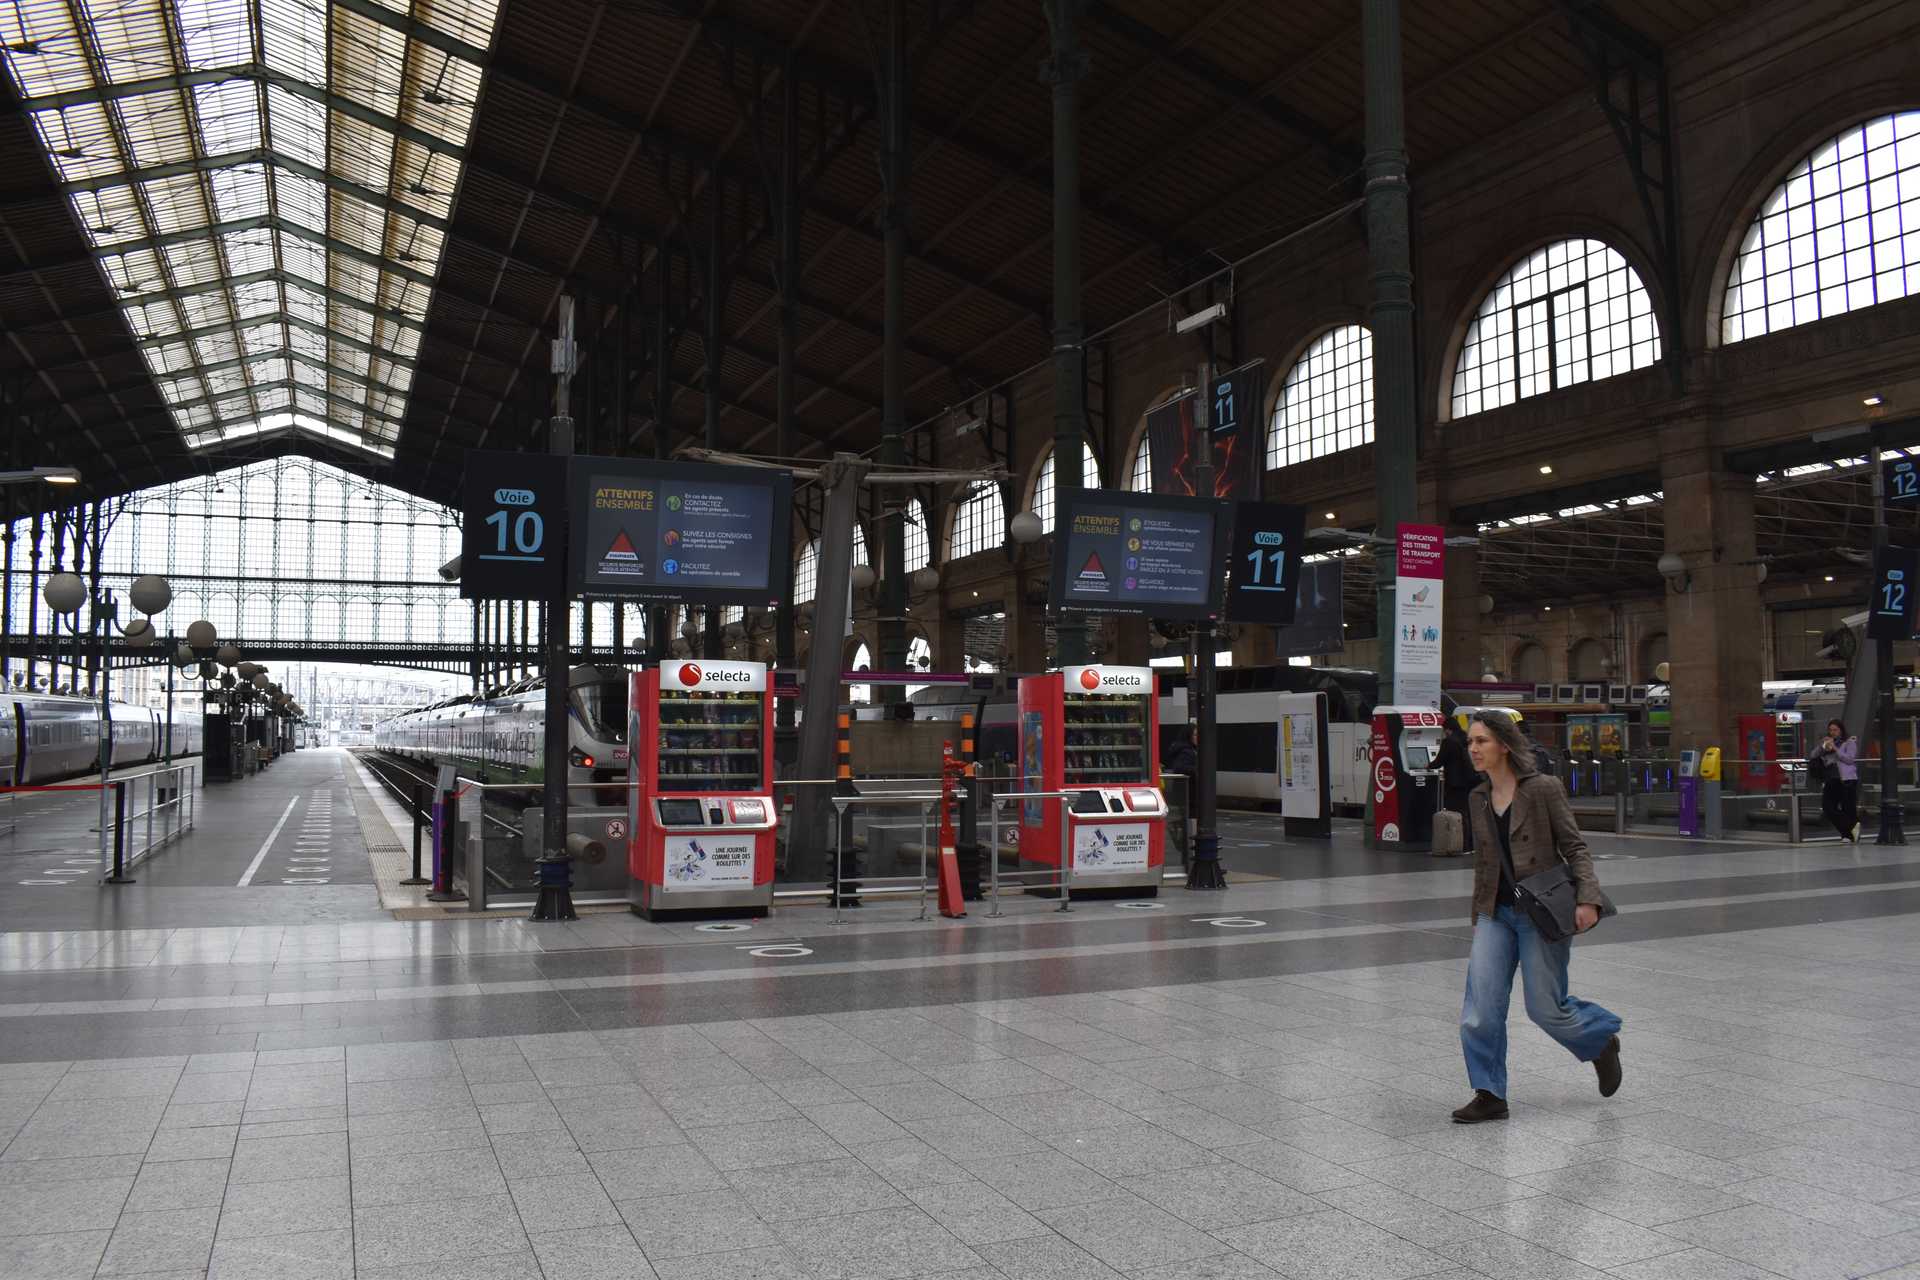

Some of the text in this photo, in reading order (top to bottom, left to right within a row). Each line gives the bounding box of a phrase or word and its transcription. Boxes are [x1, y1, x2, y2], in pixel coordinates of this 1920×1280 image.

[1215, 394, 1233, 425] 11
[1893, 472, 1917, 494] 12
[500, 490, 529, 503] Voie
[595, 487, 654, 500] ATTENTIFS
[595, 498, 654, 511] ENSEMBLE
[684, 499, 722, 507] CONTACTEZ
[1073, 514, 1120, 526] ATTENTIFS
[485, 510, 544, 553] 10
[682, 530, 704, 538] SUIVEZ
[717, 532, 753, 540] CONSIGNES
[1072, 524, 1121, 535] ENSEMBLE
[1258, 533, 1279, 544] Voie
[1402, 532, 1438, 542] VÉRIFICATION
[1402, 541, 1430, 550] DES TITRES
[1411, 550, 1441, 558] TRANSPORT
[680, 562, 711, 570] FACILITEZ
[1248, 549, 1285, 585] 11
[1881, 583, 1904, 610] 12
[704, 669, 751, 682] selecta
[1102, 674, 1141, 686] selecta
